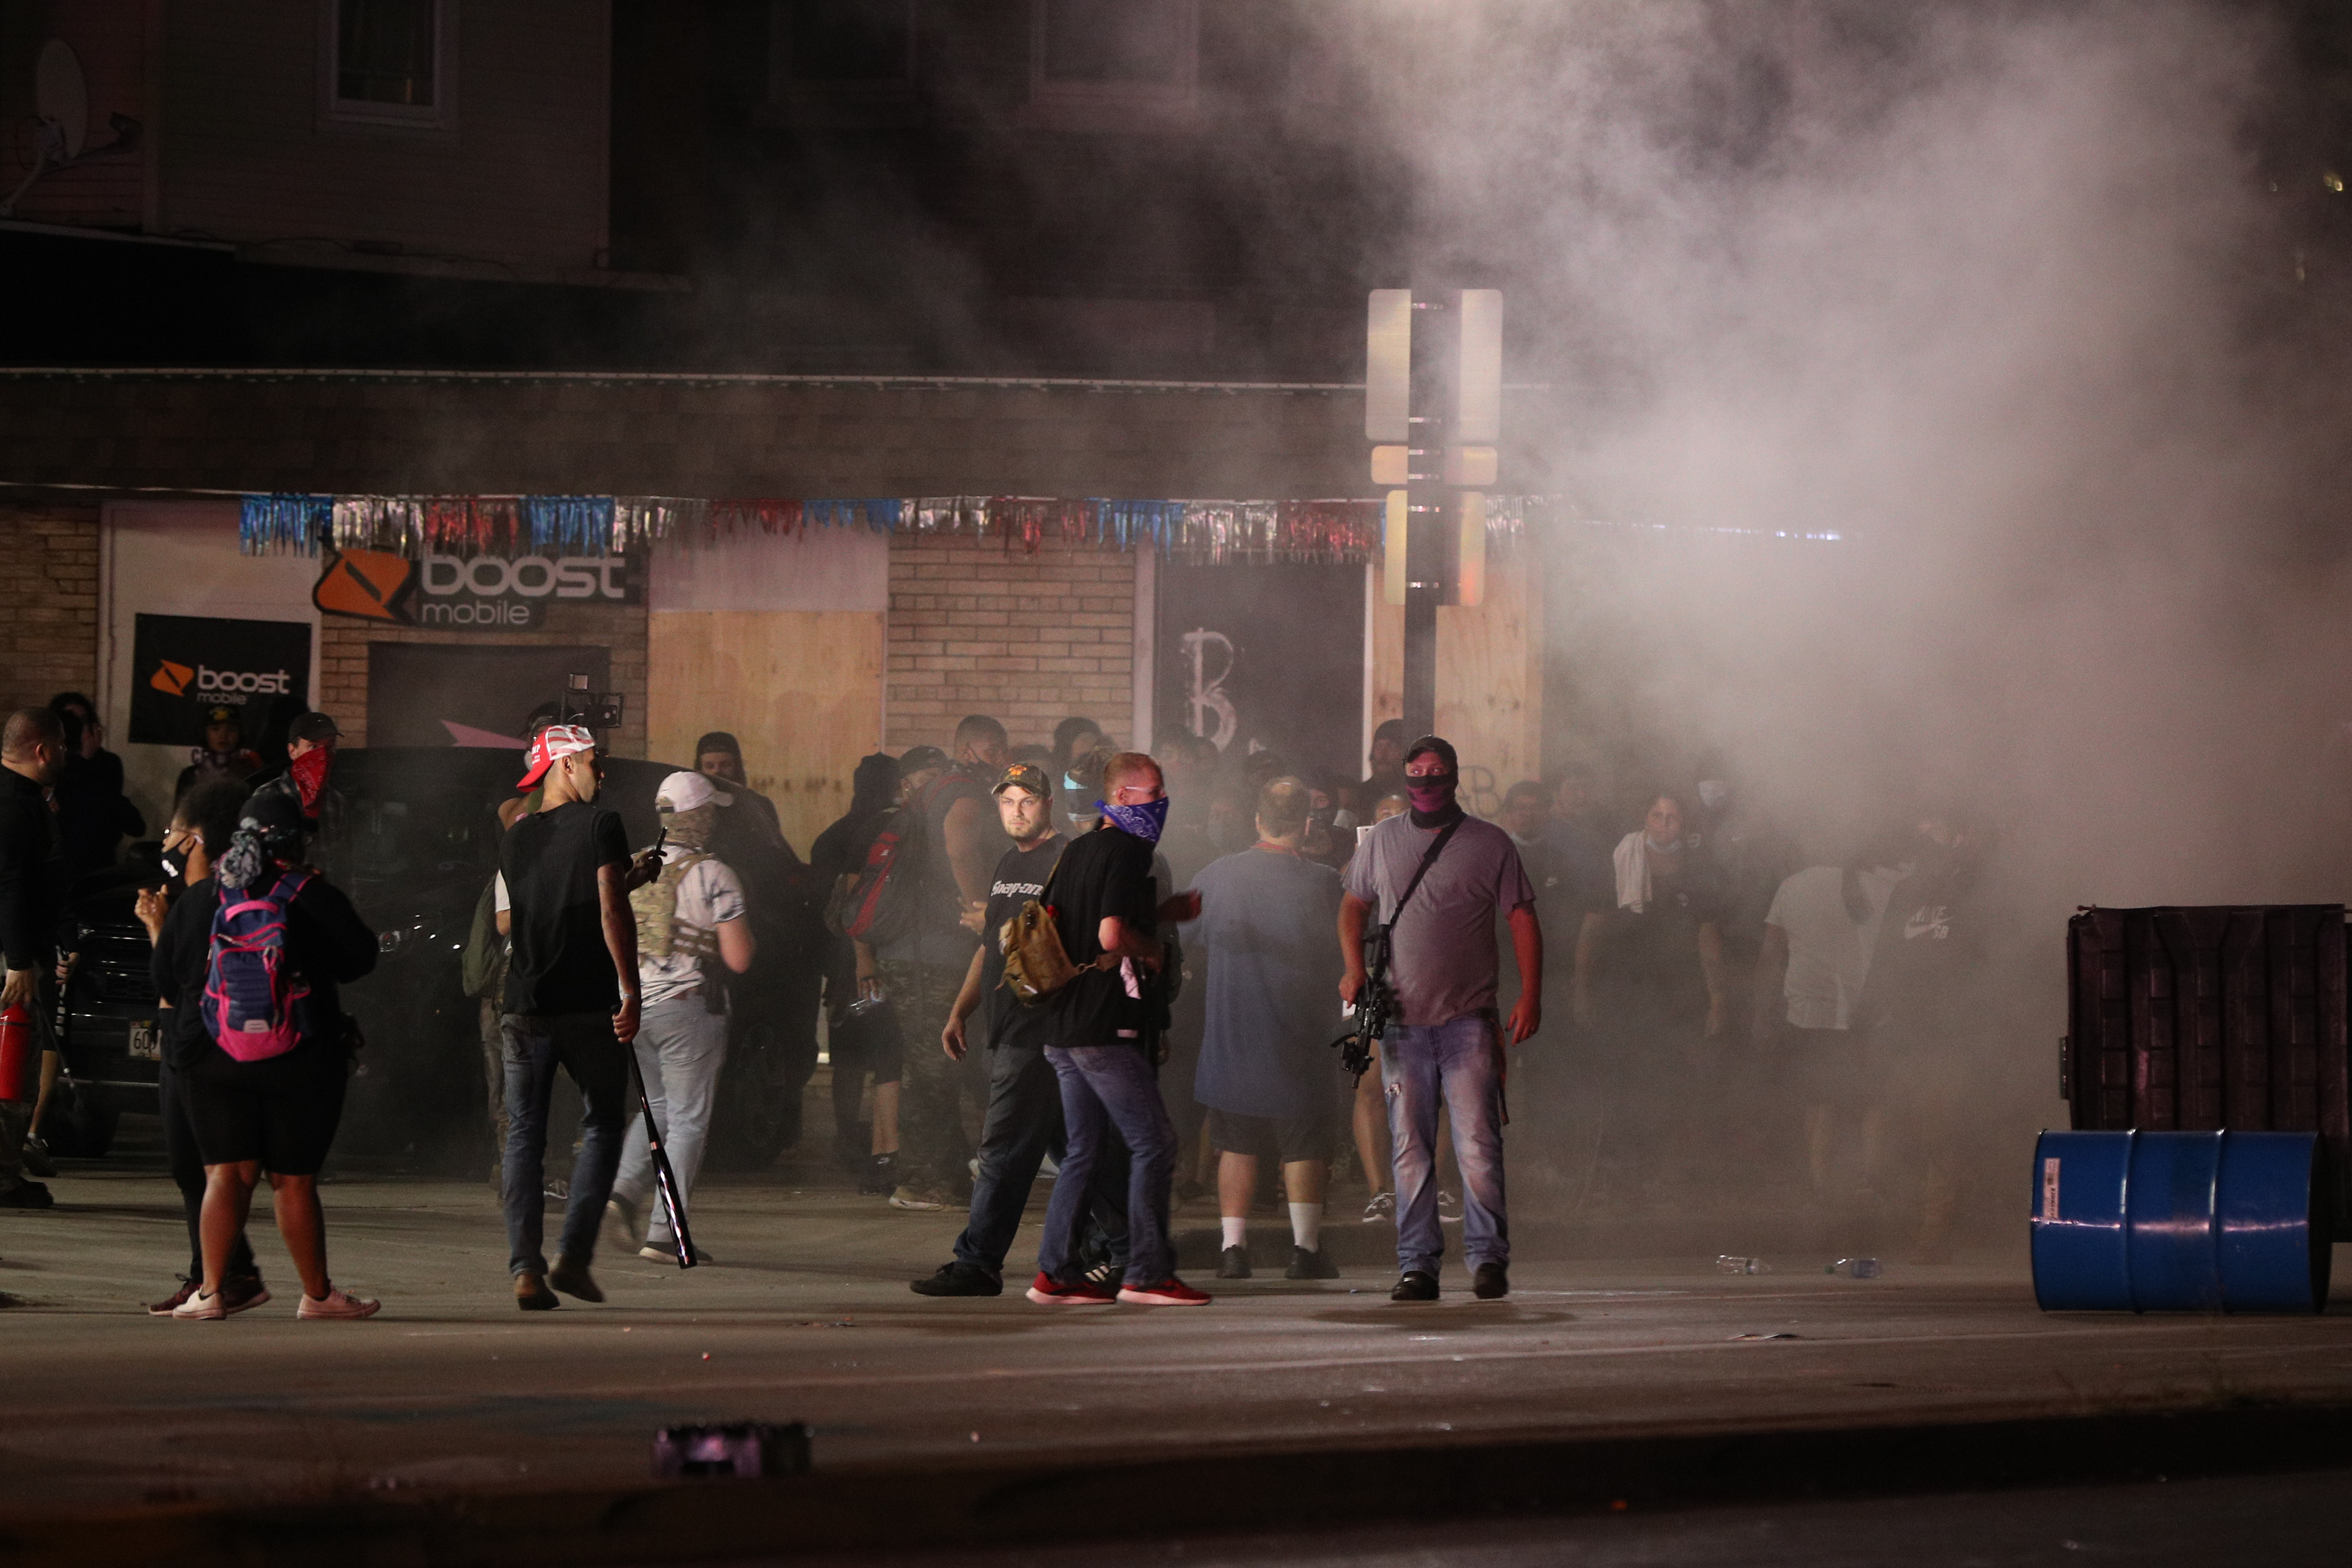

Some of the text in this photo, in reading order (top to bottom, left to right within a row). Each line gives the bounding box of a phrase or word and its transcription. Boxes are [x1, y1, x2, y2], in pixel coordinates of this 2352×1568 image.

[421, 547, 625, 598] boost
[422, 600, 530, 625] mobile
[197, 664, 291, 695] boost
[197, 691, 248, 705] mobile
